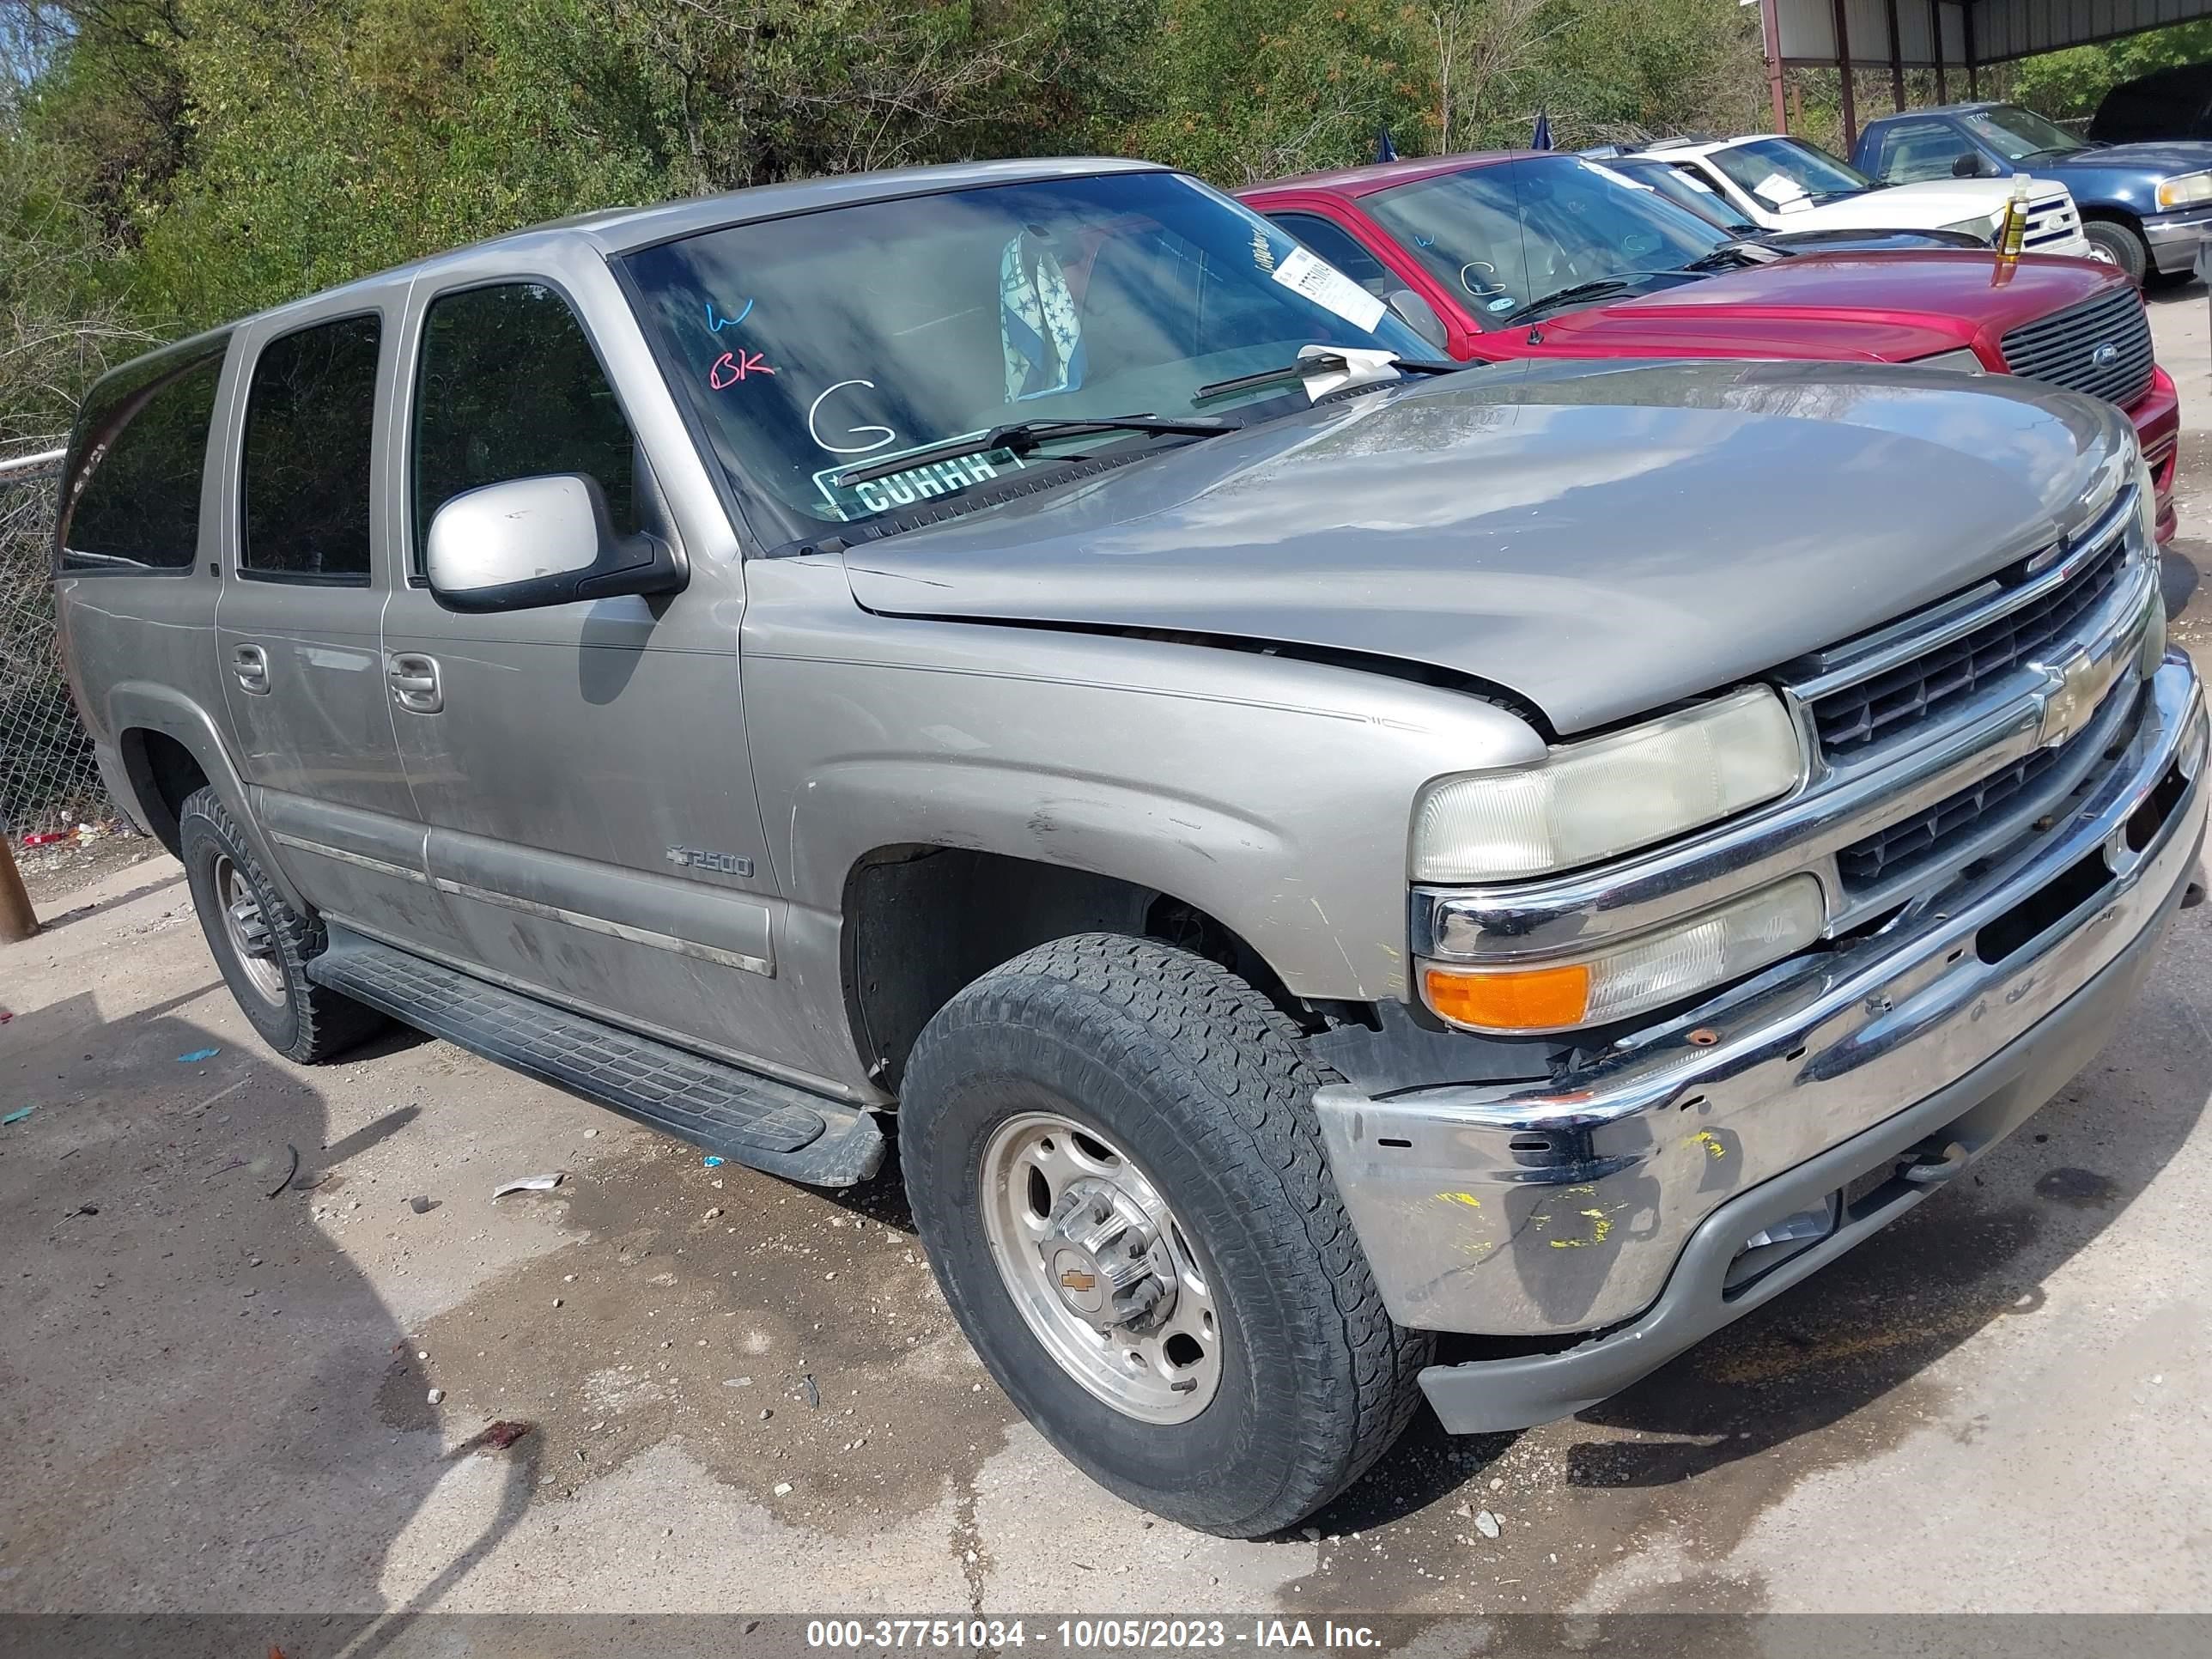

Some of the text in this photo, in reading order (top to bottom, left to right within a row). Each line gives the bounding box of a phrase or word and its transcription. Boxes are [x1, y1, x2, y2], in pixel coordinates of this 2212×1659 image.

[1461, 262, 1507, 296] G
[709, 348, 775, 391] BK
[808, 379, 896, 453] G
[692, 850, 752, 877] 2500
